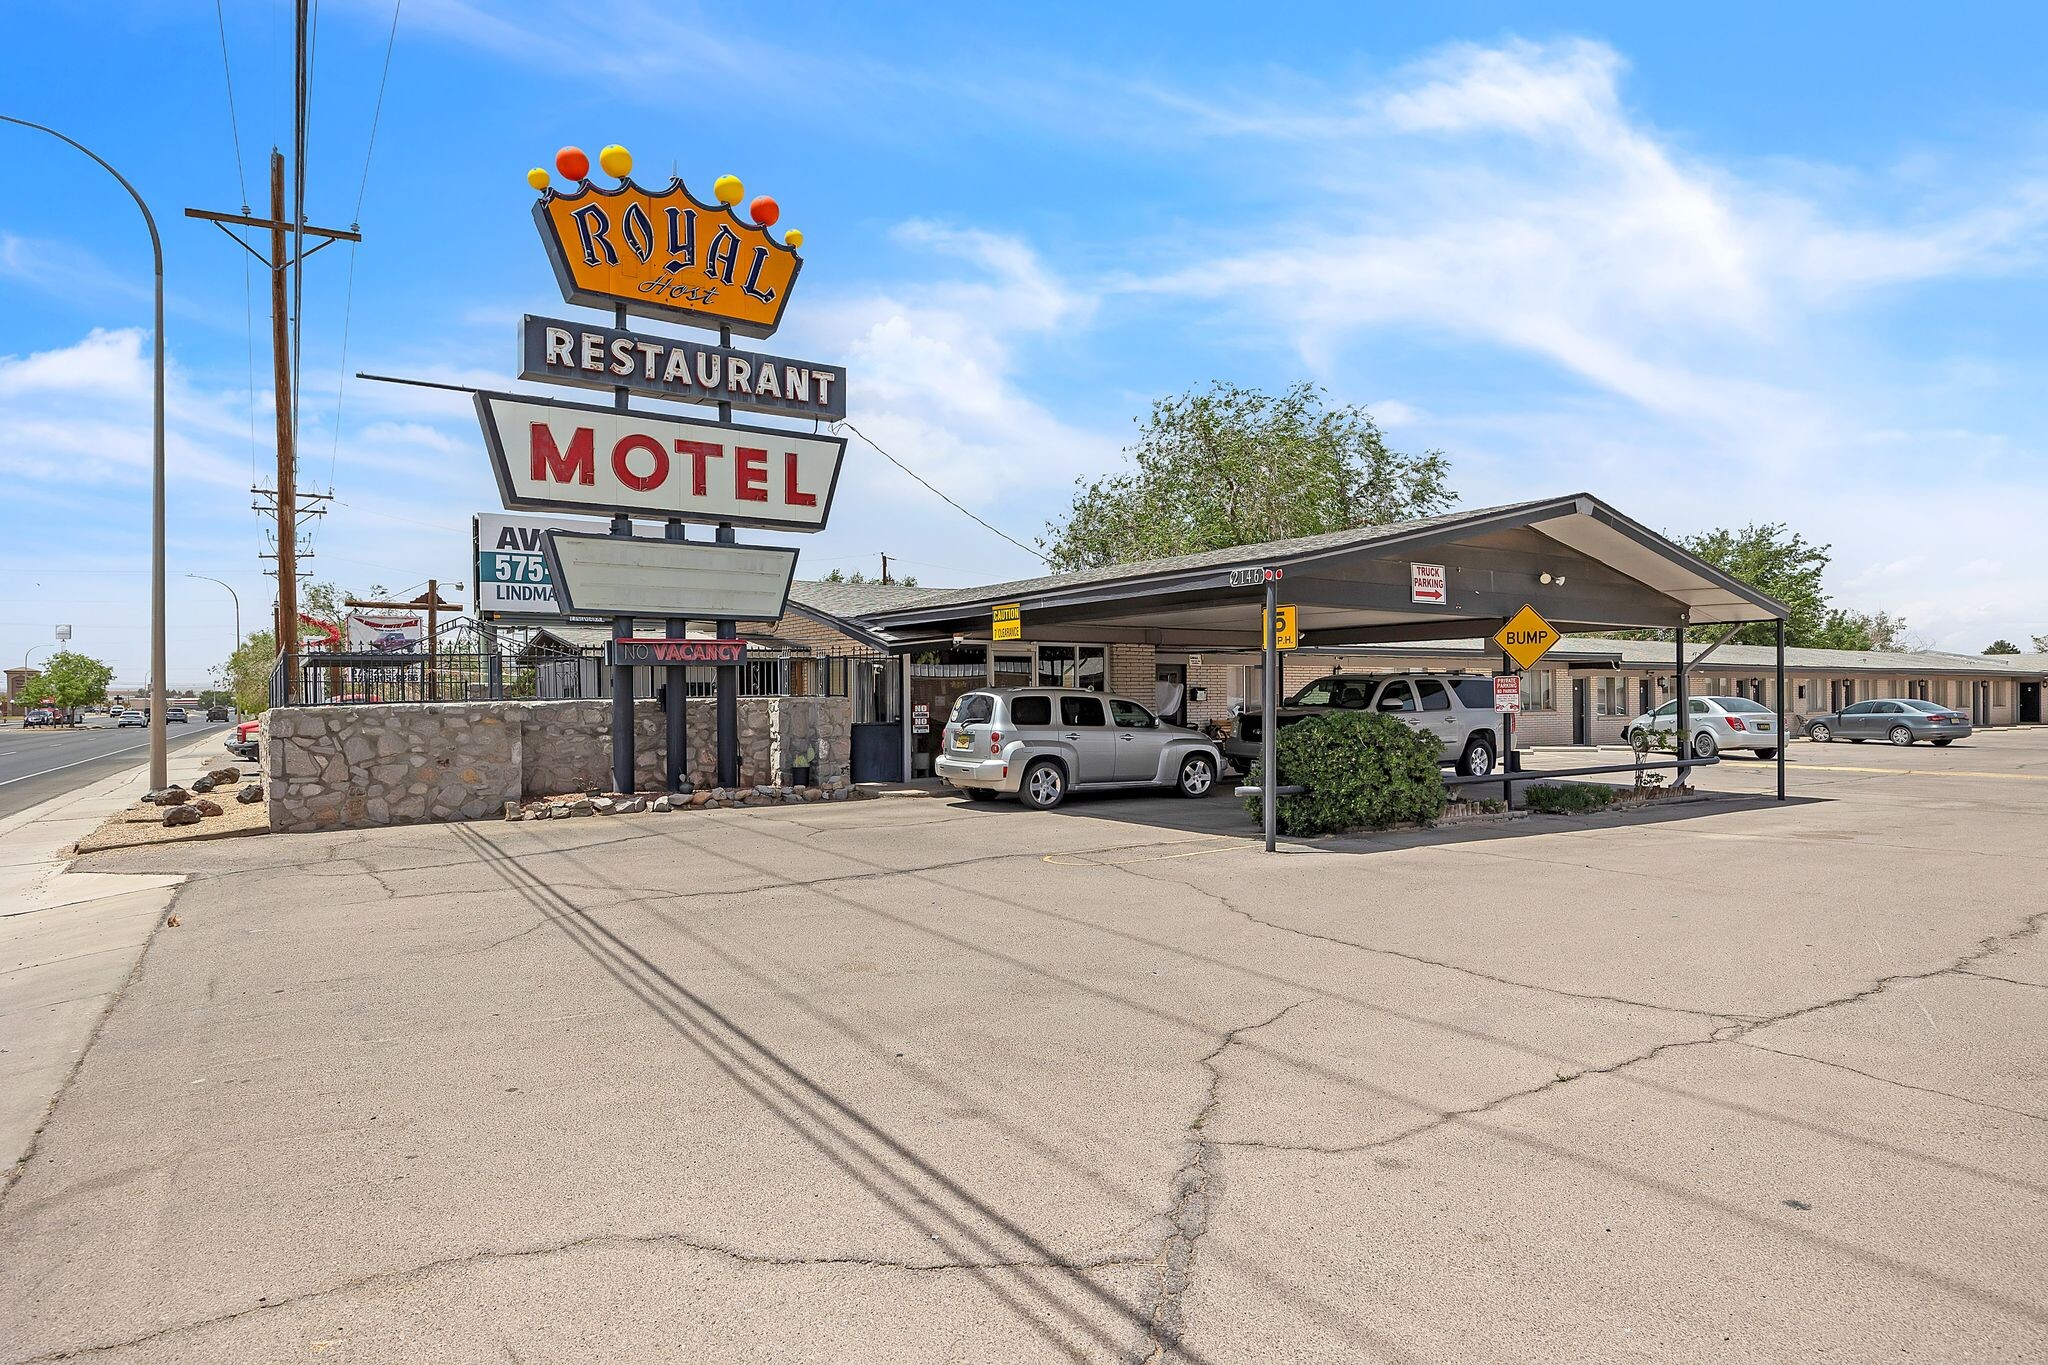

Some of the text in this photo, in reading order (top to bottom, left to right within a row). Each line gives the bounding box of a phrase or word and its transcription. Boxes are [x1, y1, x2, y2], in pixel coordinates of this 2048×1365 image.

[570, 202, 776, 304] ROYAL
[638, 272, 720, 304] Host
[546, 326, 835, 405] RESTAURANT
[529, 421, 817, 508] MOTEL
[496, 526, 543, 552] AV
[1233, 569, 1259, 585] 2146
[1416, 566, 1440, 577] TRUCK
[1414, 578, 1444, 588] PARKING
[993, 607, 1019, 621] CAUTION
[1277, 636, 1294, 645] P.H.
[1506, 630, 1548, 645] BUMP
[624, 643, 742, 661] NO VACANCY
